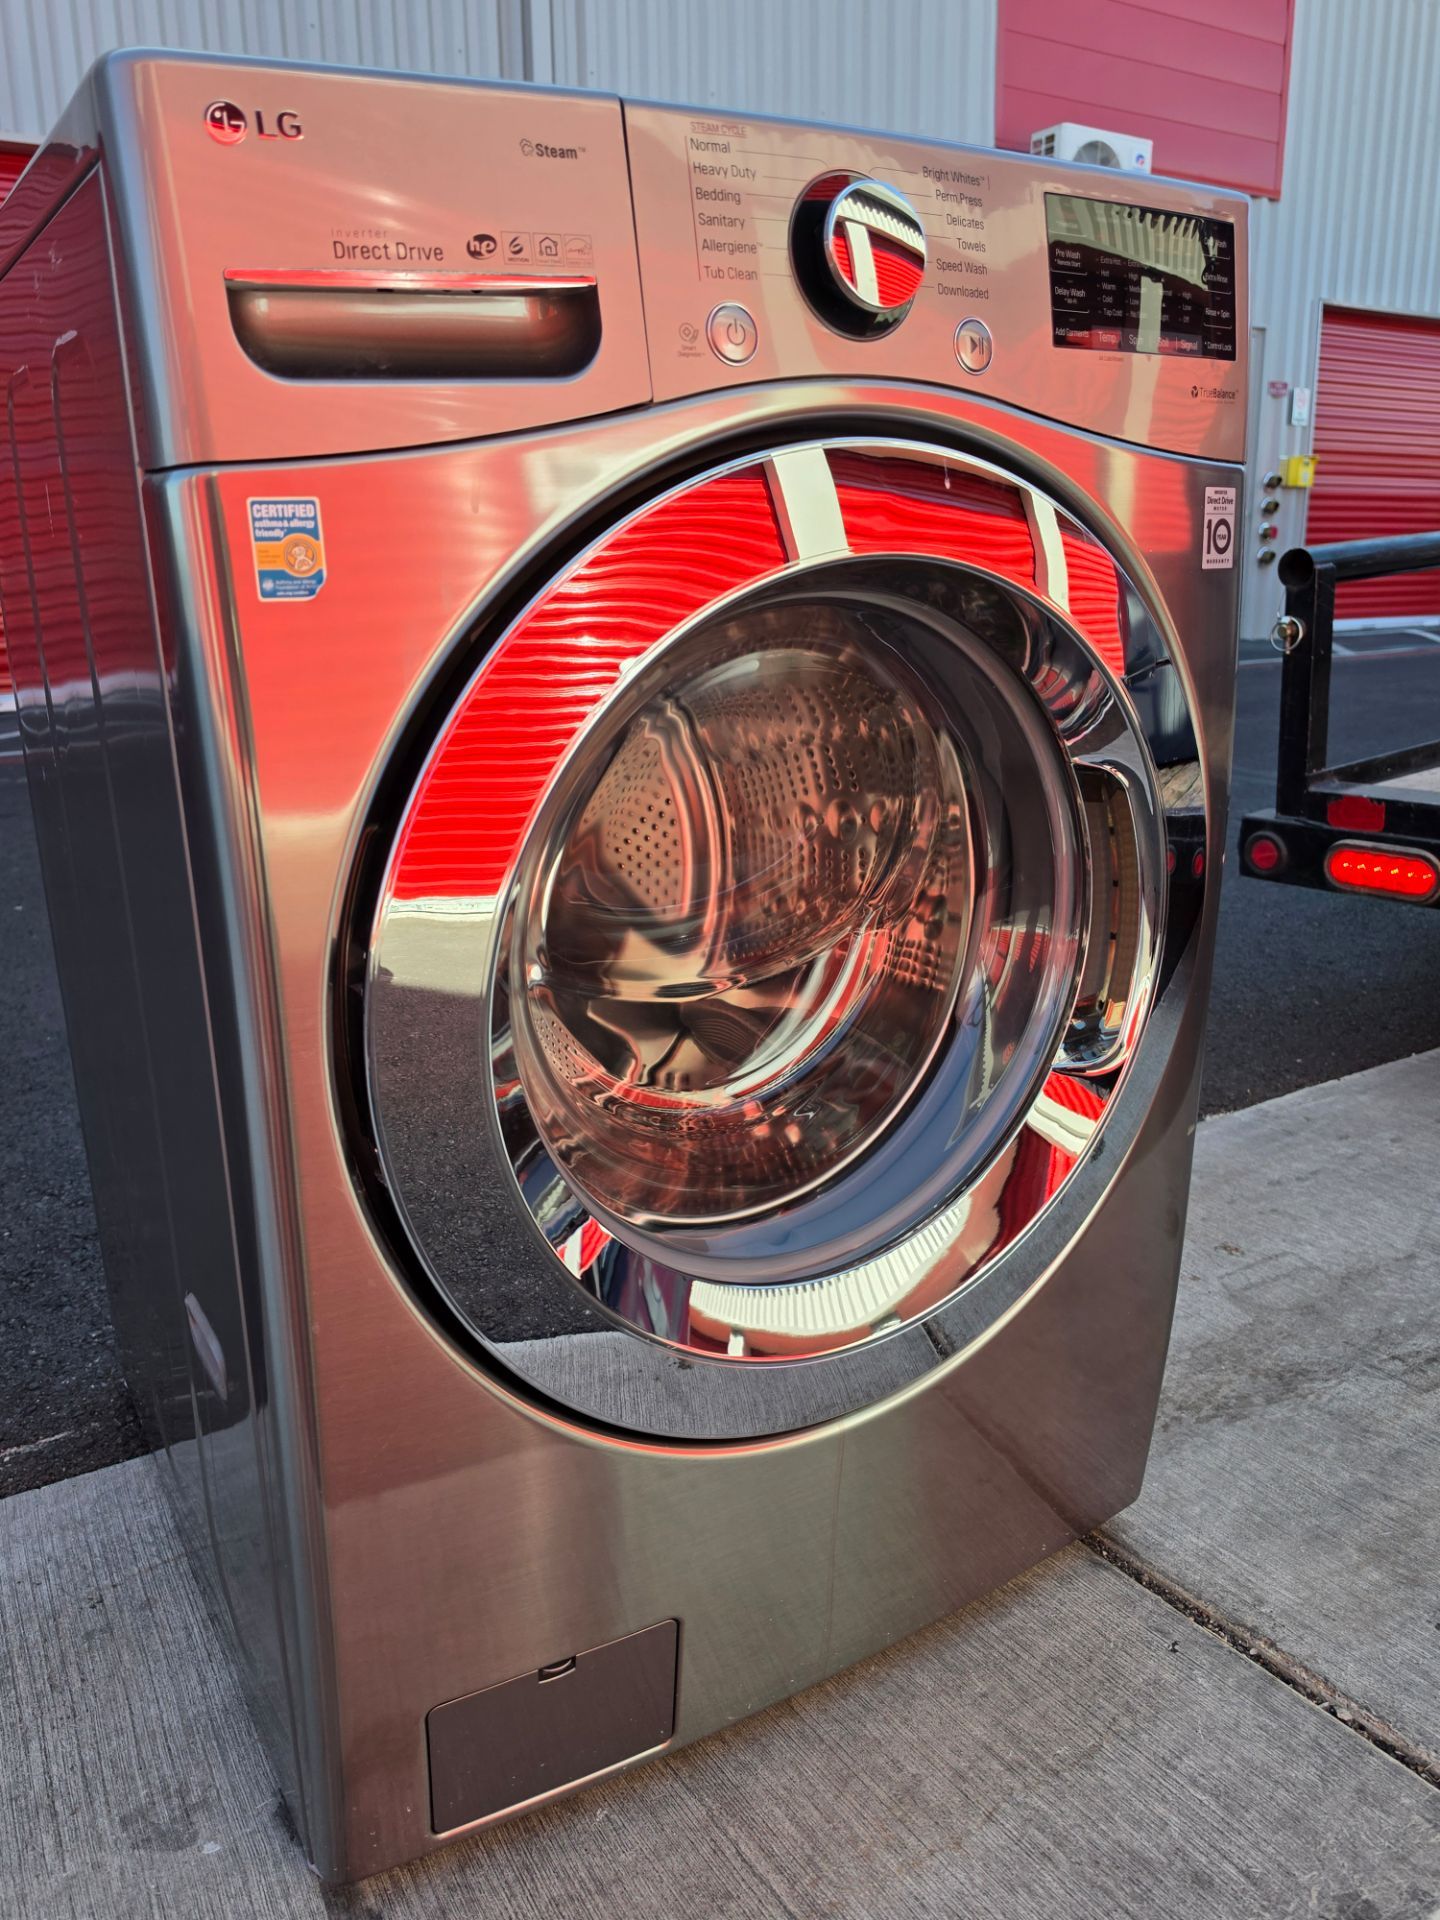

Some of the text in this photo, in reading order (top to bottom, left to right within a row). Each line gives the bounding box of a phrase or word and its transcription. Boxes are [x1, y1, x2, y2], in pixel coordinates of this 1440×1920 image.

[254, 109, 304, 141] LG
[690, 137, 731, 153] Normal
[693, 161, 756, 181] Heavy Duty
[922, 166, 949, 182] Bright
[695, 186, 741, 206] Bedding
[698, 212, 745, 230] Sanitary
[946, 213, 985, 231] Delicates
[331, 229, 387, 239] Inverter
[333, 240, 444, 262] Direct Drive
[956, 238, 986, 252] Towels
[1055, 248, 1081, 260] Pre Wash
[704, 265, 758, 281] Tub Clean
[936, 258, 987, 275] Speed Wash
[937, 283, 989, 300] Downloaded
[1055, 286, 1086, 298] Delay Wash
[1102, 282, 1116, 291] Warm
[1055, 327, 1089, 338] Add Garments
[1181, 339, 1198, 351] Signal
[1207, 496, 1234, 505] Direct Drive
[252, 503, 315, 518] CERTIFIED
[1206, 518, 1232, 555] 10
